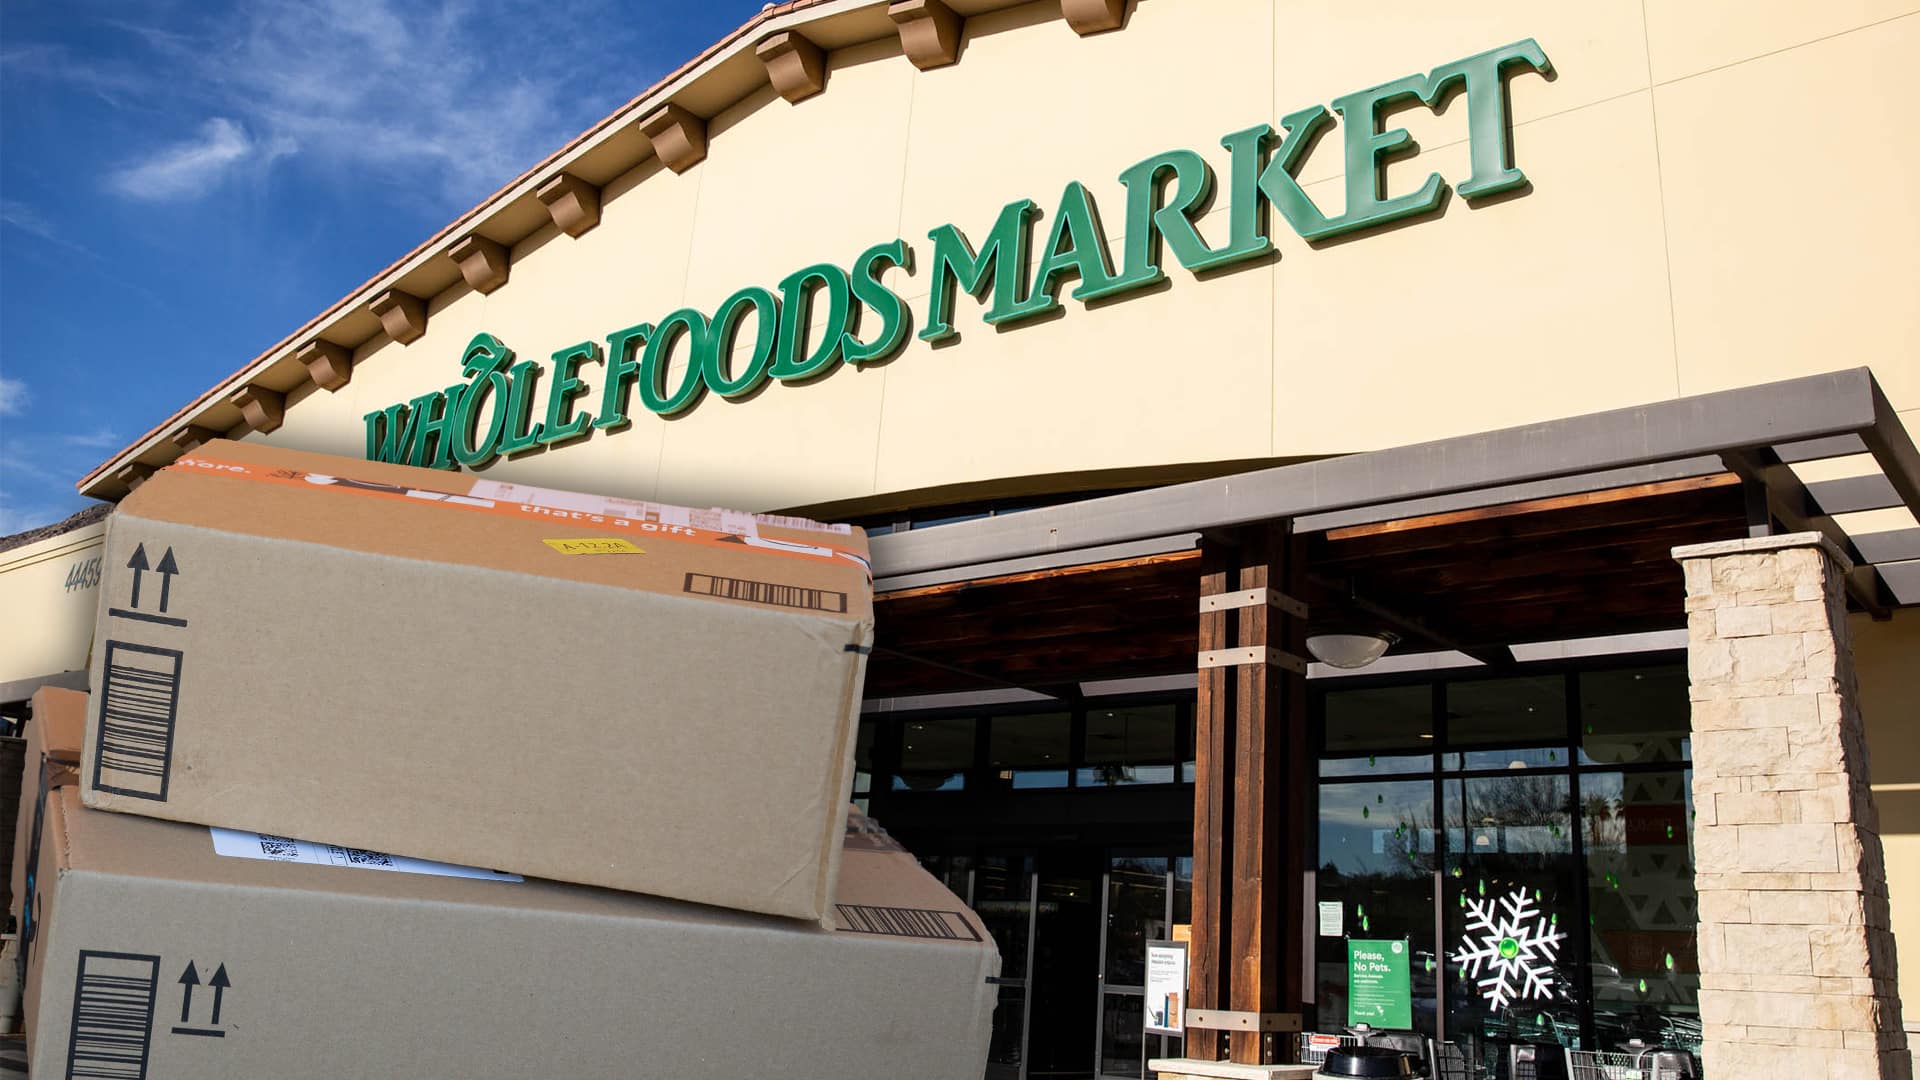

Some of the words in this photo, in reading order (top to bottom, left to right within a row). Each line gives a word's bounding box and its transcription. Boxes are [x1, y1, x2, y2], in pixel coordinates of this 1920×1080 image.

[363, 332, 602, 470] WHOLE
[593, 238, 913, 430] FOODS
[918, 38, 1552, 342] MARKET
[520, 504, 604, 523] that's
[614, 518, 630, 527] a
[641, 522, 697, 536] gift
[1353, 950, 1385, 961] Please,
[1353, 961, 1367, 971] No
[1369, 962, 1391, 972] Pets.
